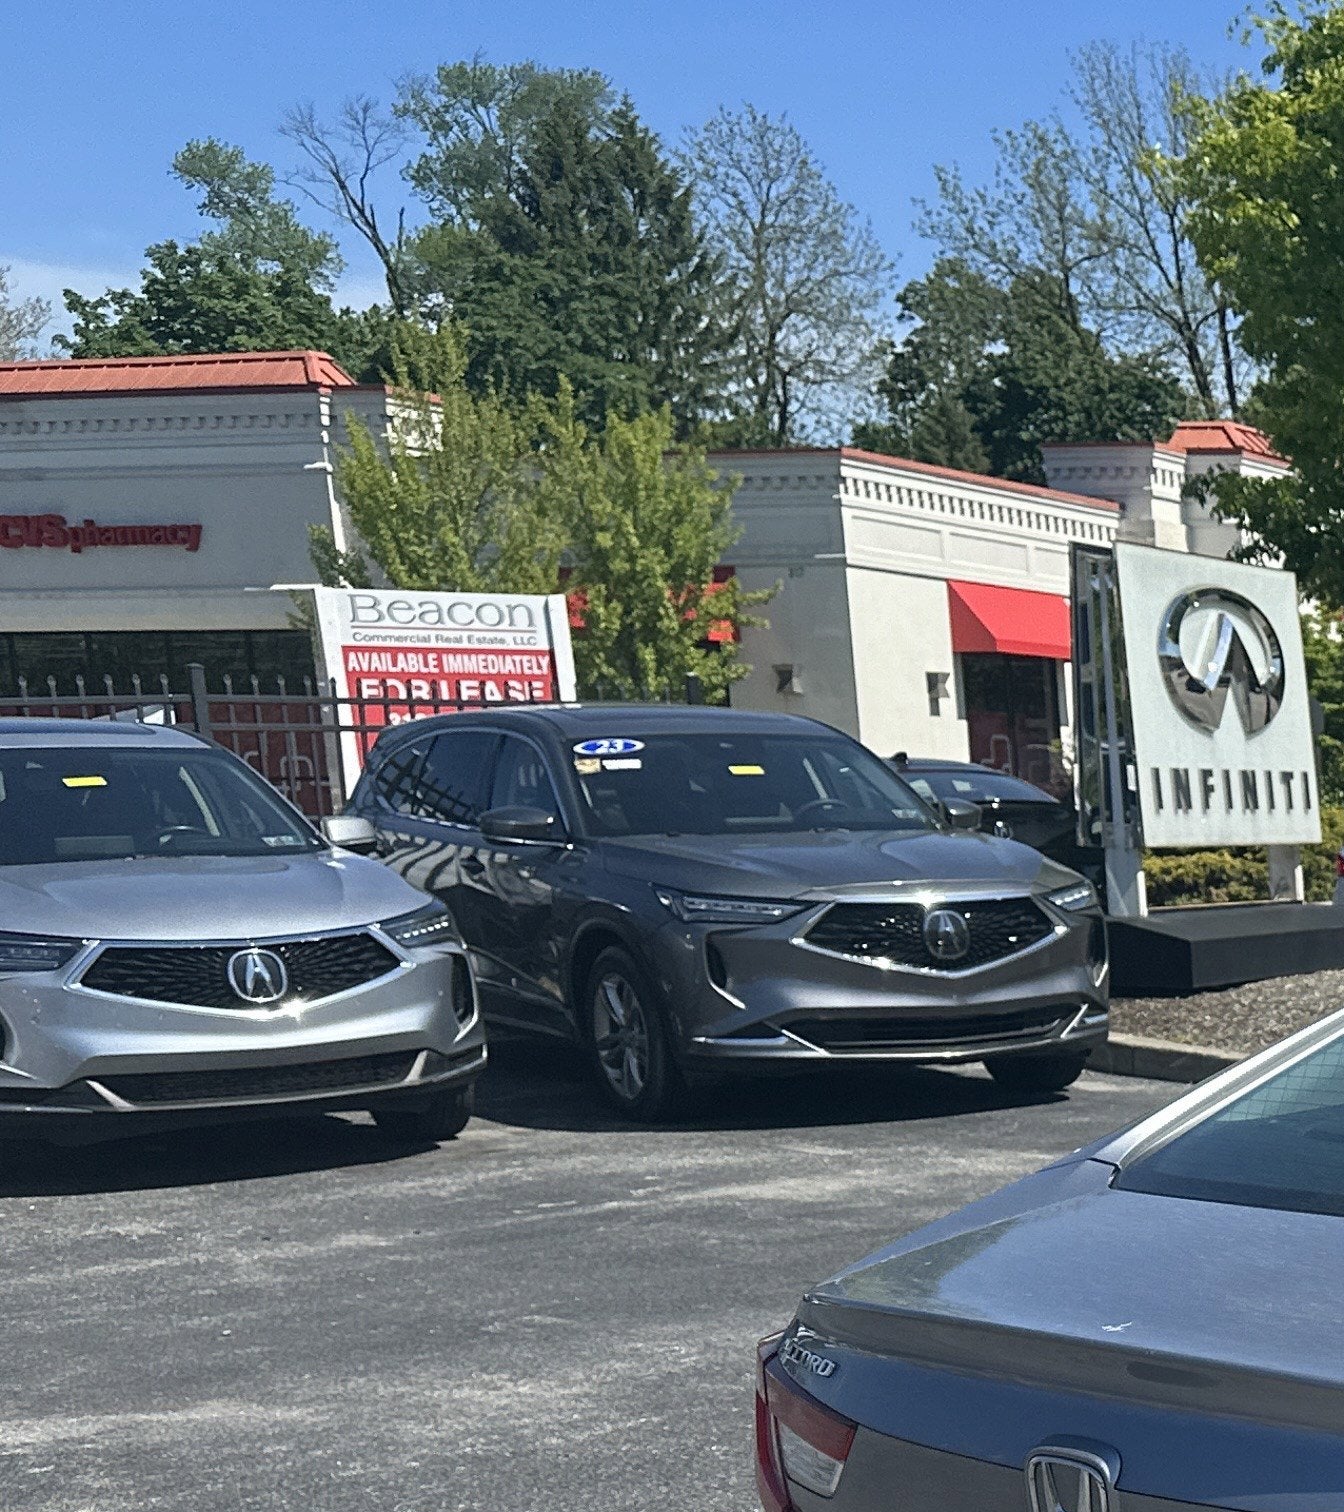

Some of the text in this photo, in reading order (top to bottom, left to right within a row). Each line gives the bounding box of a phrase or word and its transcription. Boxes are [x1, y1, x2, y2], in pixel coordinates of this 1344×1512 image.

[67, 519, 202, 554] pharmacy
[347, 594, 537, 628] Beacon
[352, 631, 432, 645] Commercial
[434, 634, 464, 645] Real
[513, 636, 538, 647] LLC
[347, 651, 550, 676] AVAILABLE IMMEDIATELY
[1150, 766, 1311, 813] INFINITI
